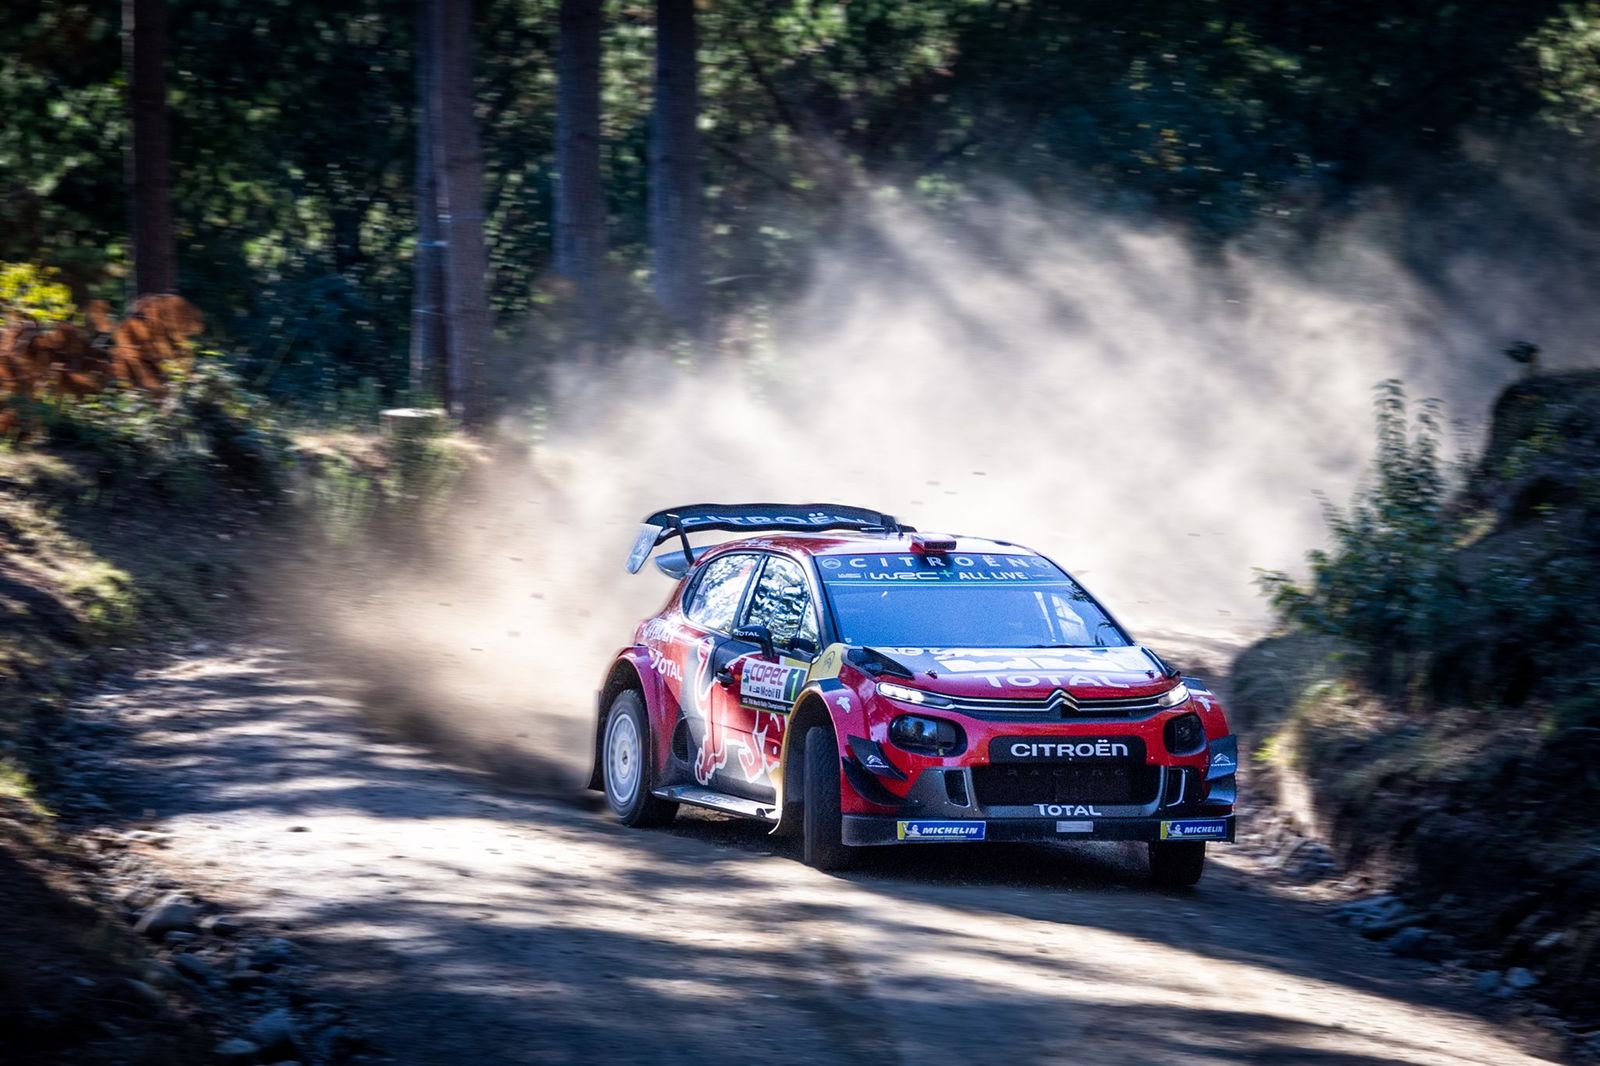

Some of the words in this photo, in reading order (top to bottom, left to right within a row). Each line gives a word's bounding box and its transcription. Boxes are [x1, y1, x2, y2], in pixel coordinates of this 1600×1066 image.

[849, 554, 1031, 568] CITROËN
[959, 571, 991, 580] ALL
[991, 571, 1029, 581] LIVE
[650, 650, 683, 682] TOTAL
[791, 669, 801, 701] 1
[973, 674, 1130, 688] TOTAL
[1010, 739, 1129, 757] CITROËN
[1033, 803, 1102, 816] TOTAL
[922, 826, 978, 835] MICHELIN
[1183, 825, 1224, 834] MICHELIN
